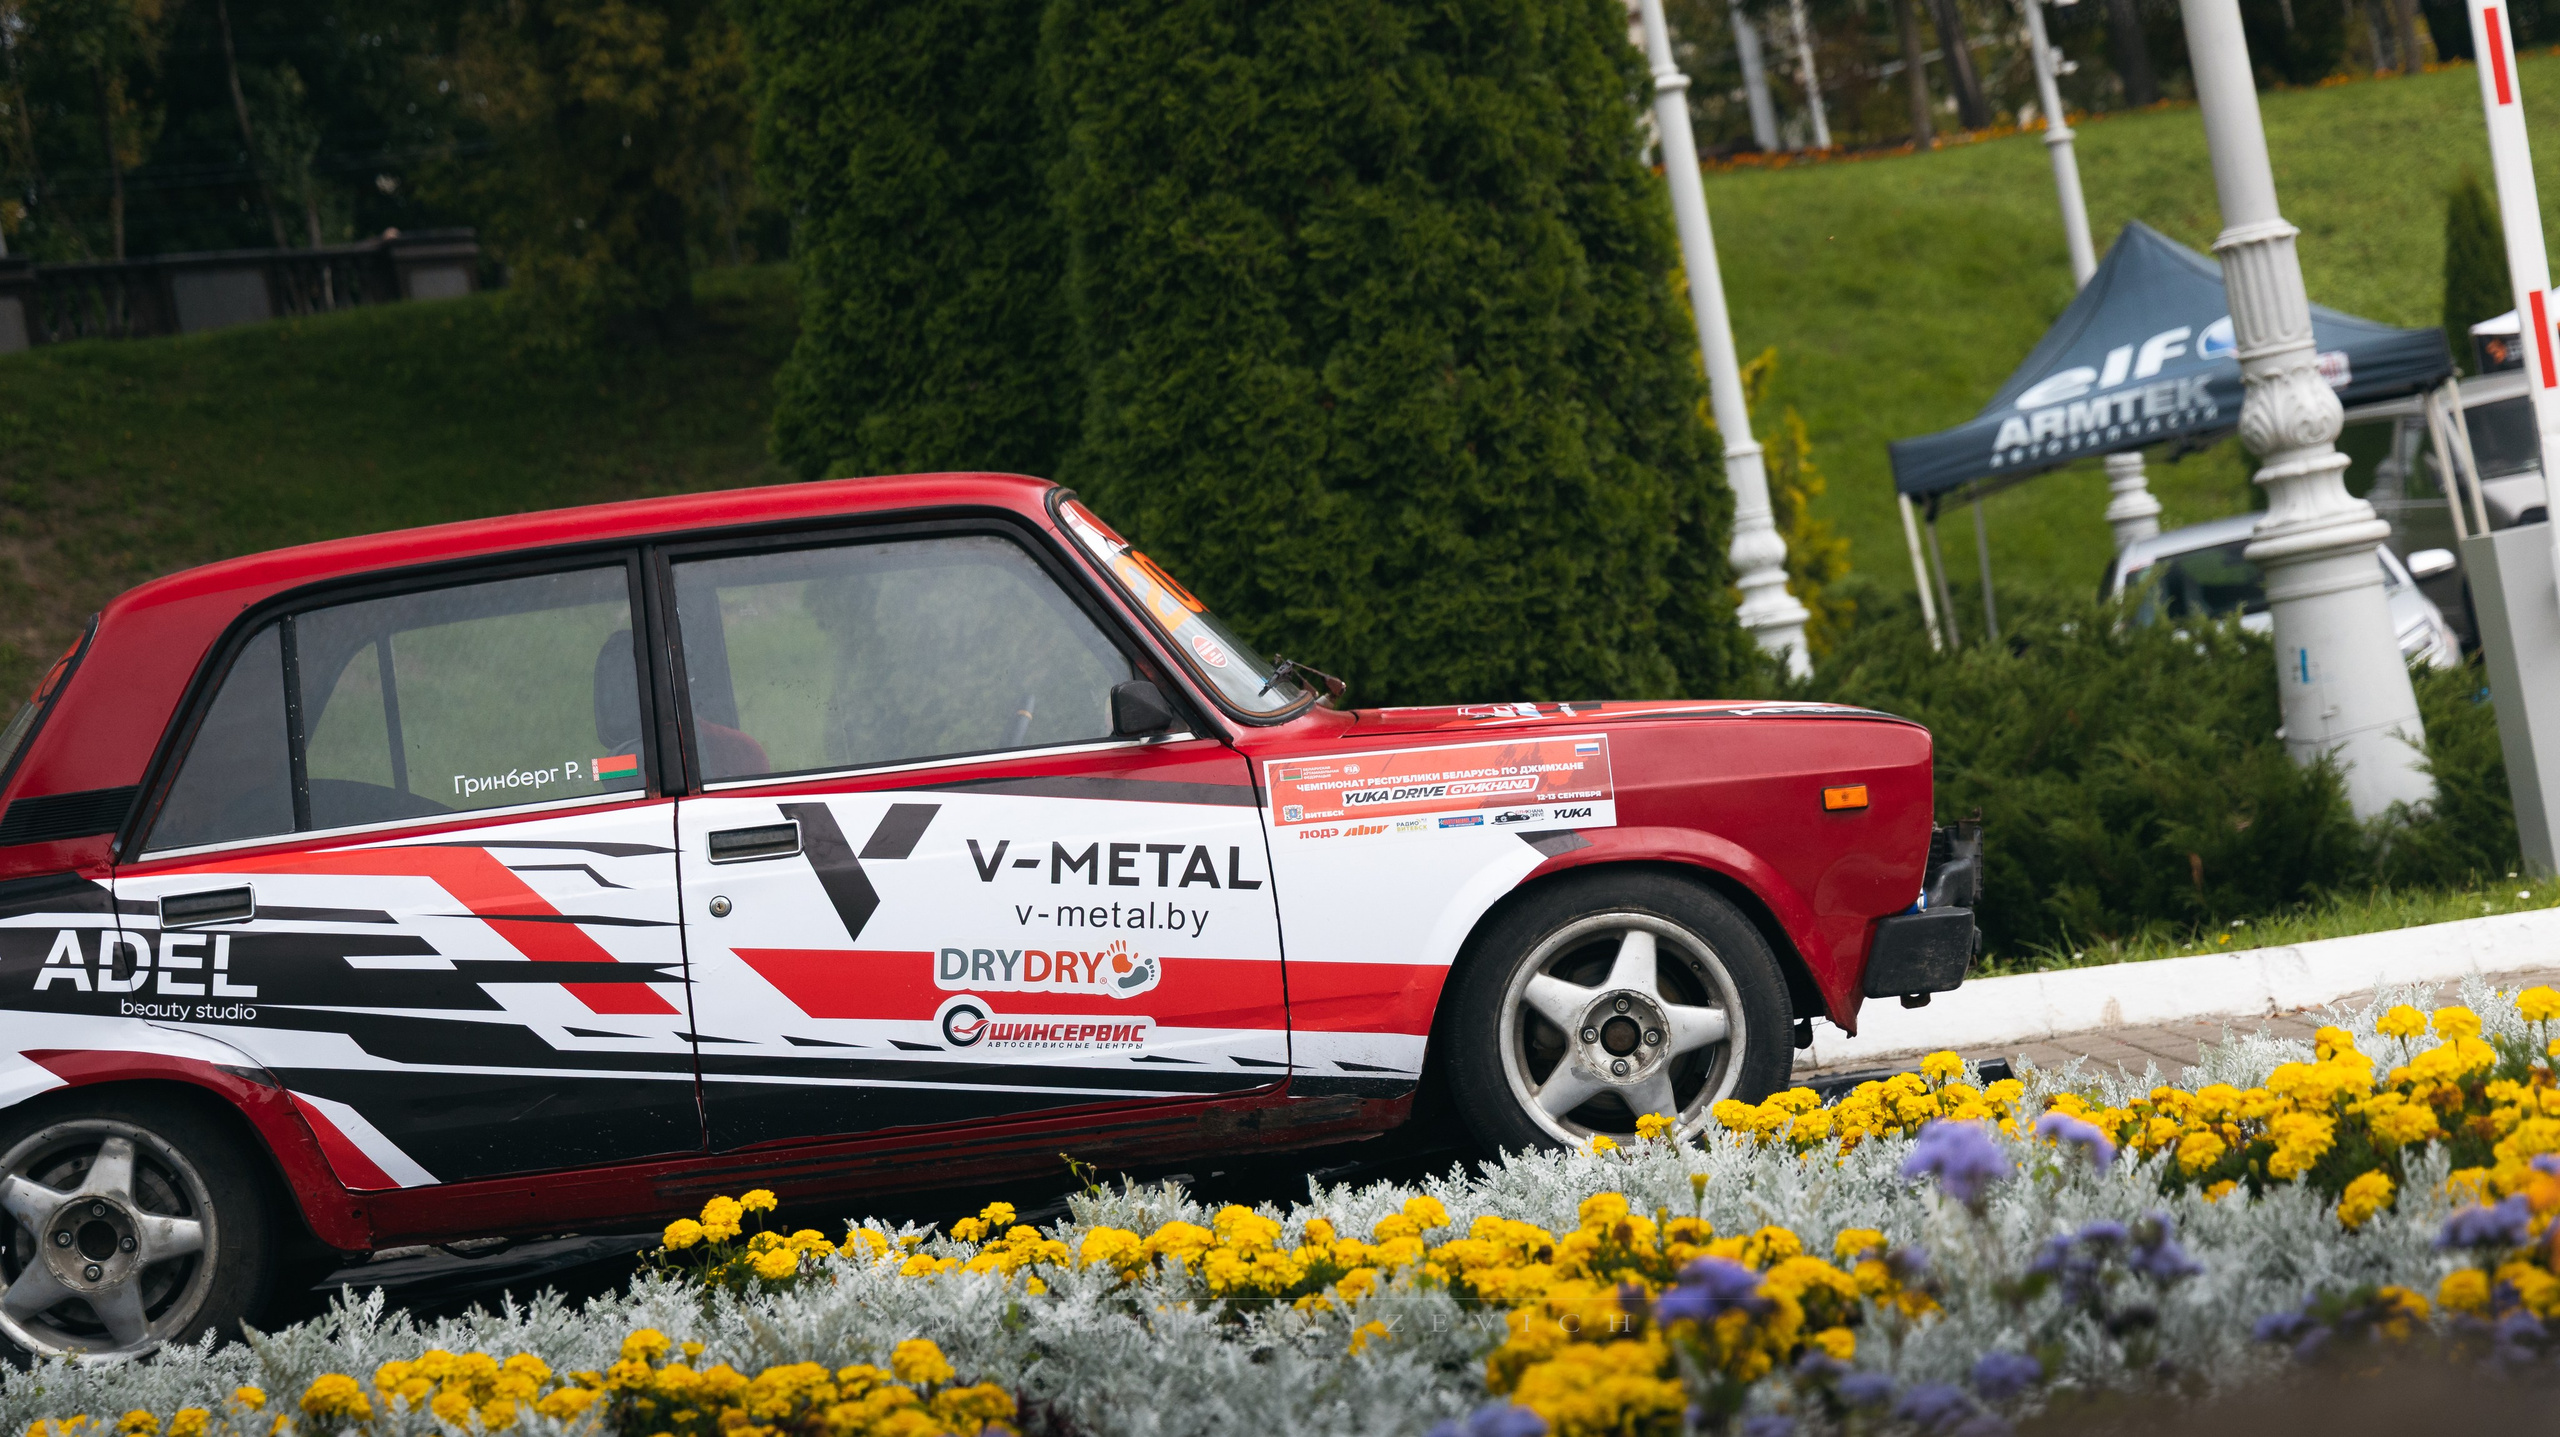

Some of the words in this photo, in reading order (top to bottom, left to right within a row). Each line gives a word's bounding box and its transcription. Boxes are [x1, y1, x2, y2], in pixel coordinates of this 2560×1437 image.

[1992, 374, 2216, 453] ARMTEK
[454, 767, 559, 797] Гринберг
[565, 761, 583, 780] Р.
[1296, 779, 1365, 792] ЧЕМПИОНАТ
[1367, 772, 1440, 786] РЕСПУБЛИКИ
[1443, 767, 1499, 780] БЕЛАРУСЬ
[1501, 766, 1517, 775] ПО
[1519, 762, 1584, 775] ДЖИМХАНЕ
[1344, 791, 1389, 805] YUKA
[1392, 785, 1447, 800] DRIVE
[1450, 779, 1530, 795] GYMKHANA
[1536, 793, 1556, 801] 12-13
[1557, 790, 1602, 800] СЕНТЯБРЯ
[1304, 810, 1344, 819] ВИТЕБСК
[1396, 820, 1419, 828] РАДИО
[1553, 807, 1592, 819] YUKA
[1396, 824, 1428, 833] ВИТЕБСК
[966, 839, 1263, 890] V-METAL
[1015, 901, 1209, 937] v-metal.by
[33, 929, 259, 998] ADEL
[121, 998, 190, 1021] beauty
[195, 1000, 257, 1021] studio
[988, 1023, 1147, 1042] ШИНСЕРВИС
[987, 1041, 1090, 1049] АВТОСЕРВИСНЫЕ
[1096, 1042, 1144, 1050] ЦЕНТРЫ
